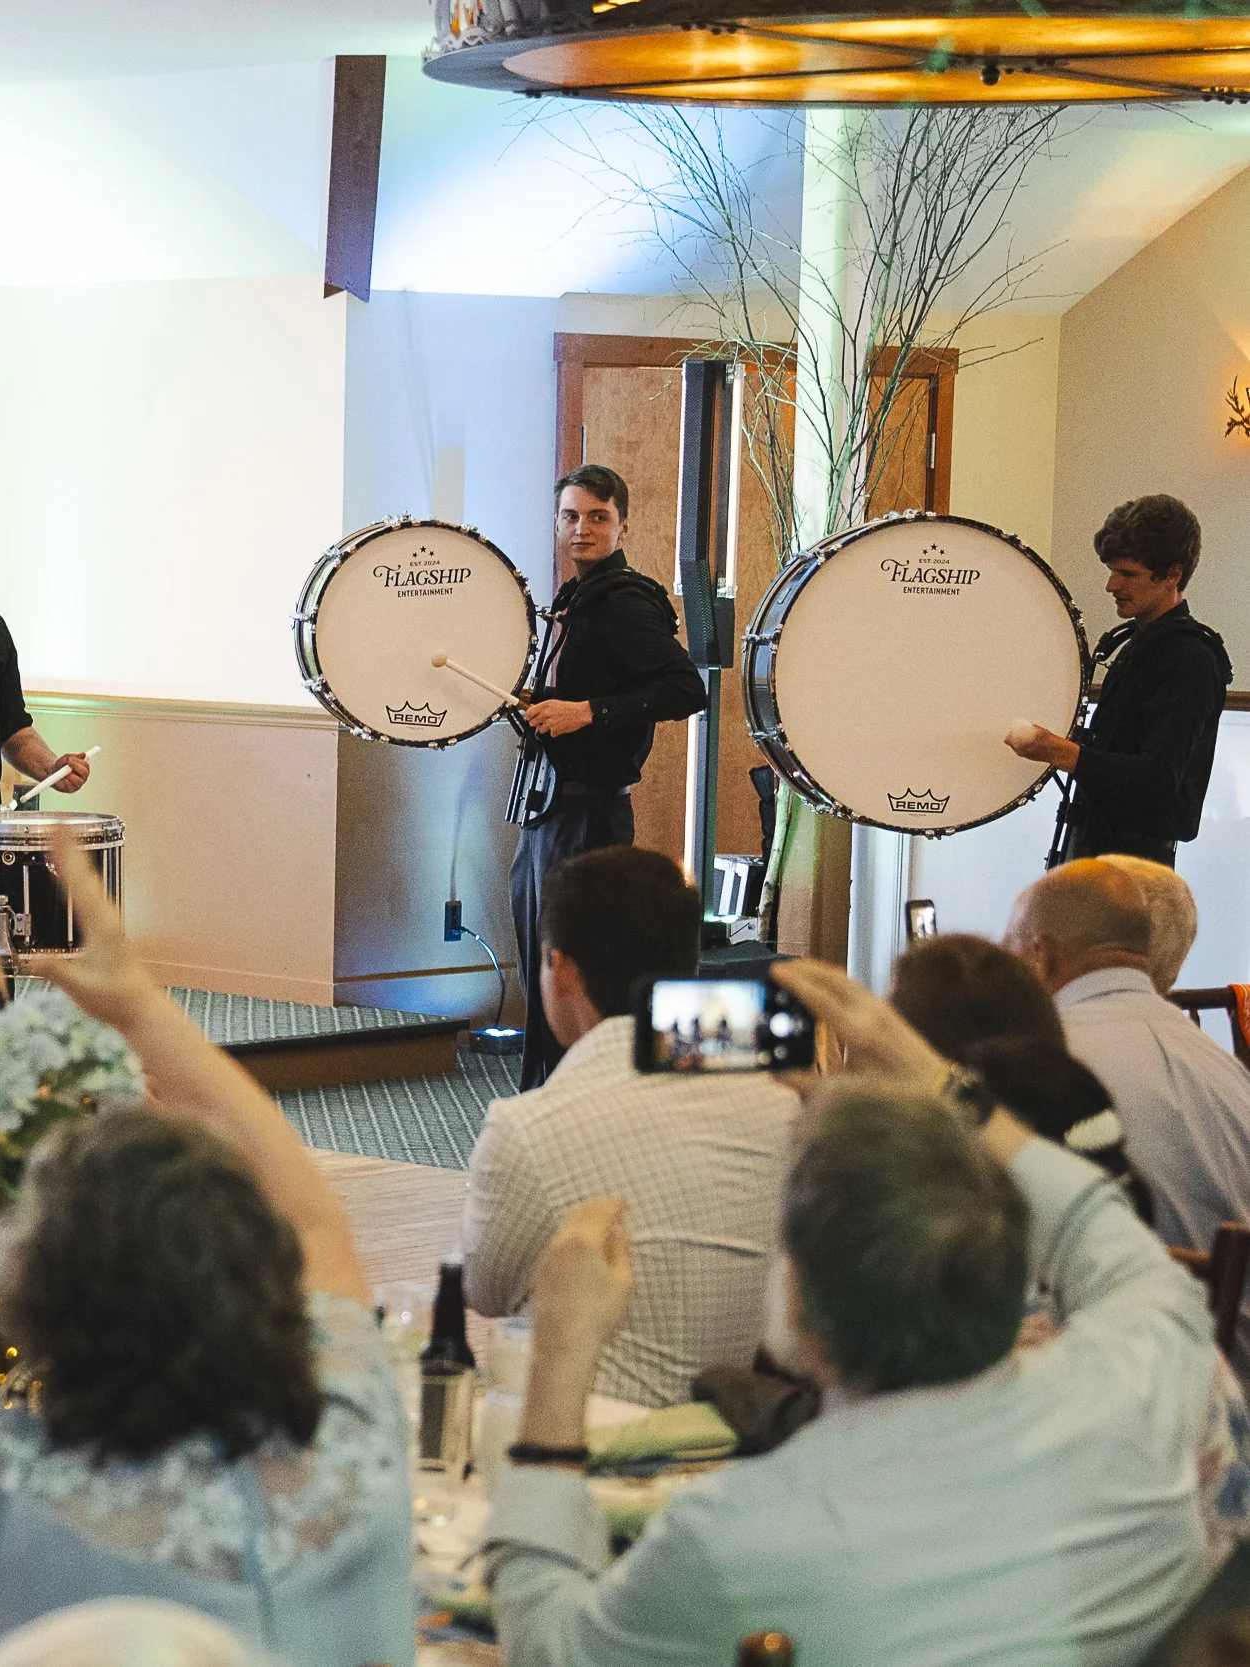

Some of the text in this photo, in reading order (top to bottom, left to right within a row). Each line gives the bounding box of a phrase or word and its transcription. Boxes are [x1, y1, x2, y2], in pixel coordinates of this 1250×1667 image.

[372, 564, 472, 588] FLAGSHIP
[880, 558, 981, 585] FLAGSHIP
[397, 587, 454, 598] ENTERTAINMENT
[903, 586, 960, 596] ENTERTAINMENT
[393, 713, 438, 724] REMO
[895, 800, 941, 811] REMO
